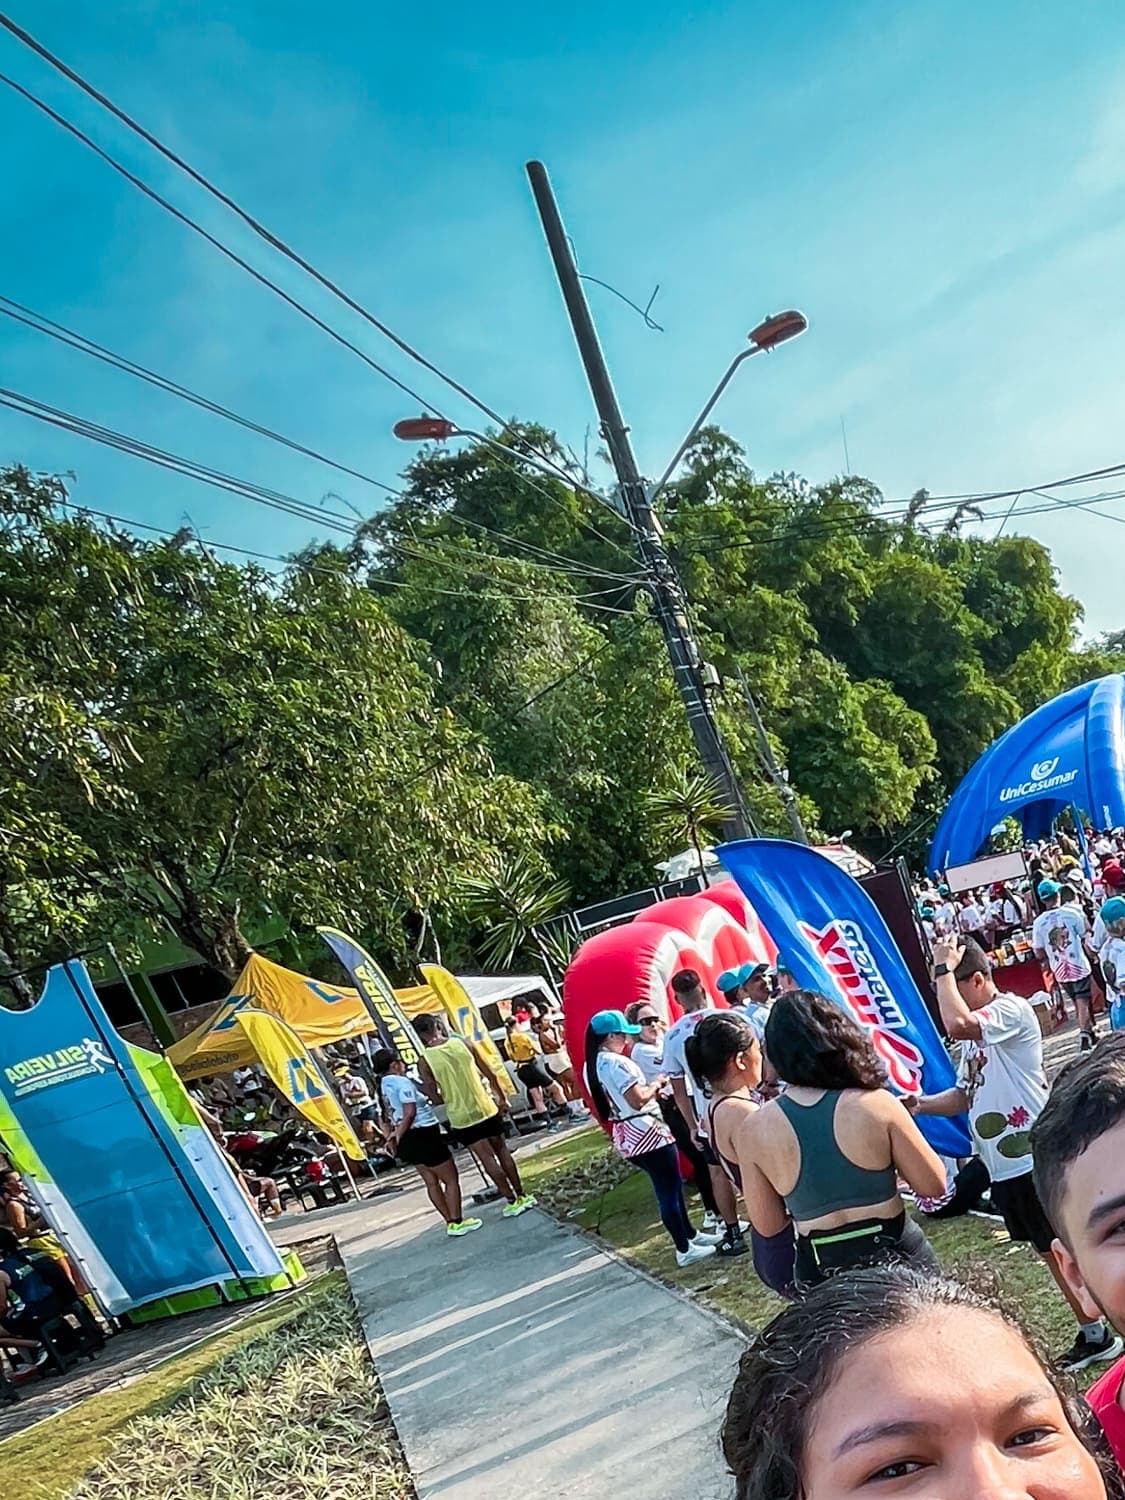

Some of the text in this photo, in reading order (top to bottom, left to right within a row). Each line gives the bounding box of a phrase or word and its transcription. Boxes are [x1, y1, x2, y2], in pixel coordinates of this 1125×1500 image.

[999, 769, 1079, 802] UniCesumar
[353, 964, 420, 1065] SILVEIRA
[839, 924, 902, 1025] mateus
